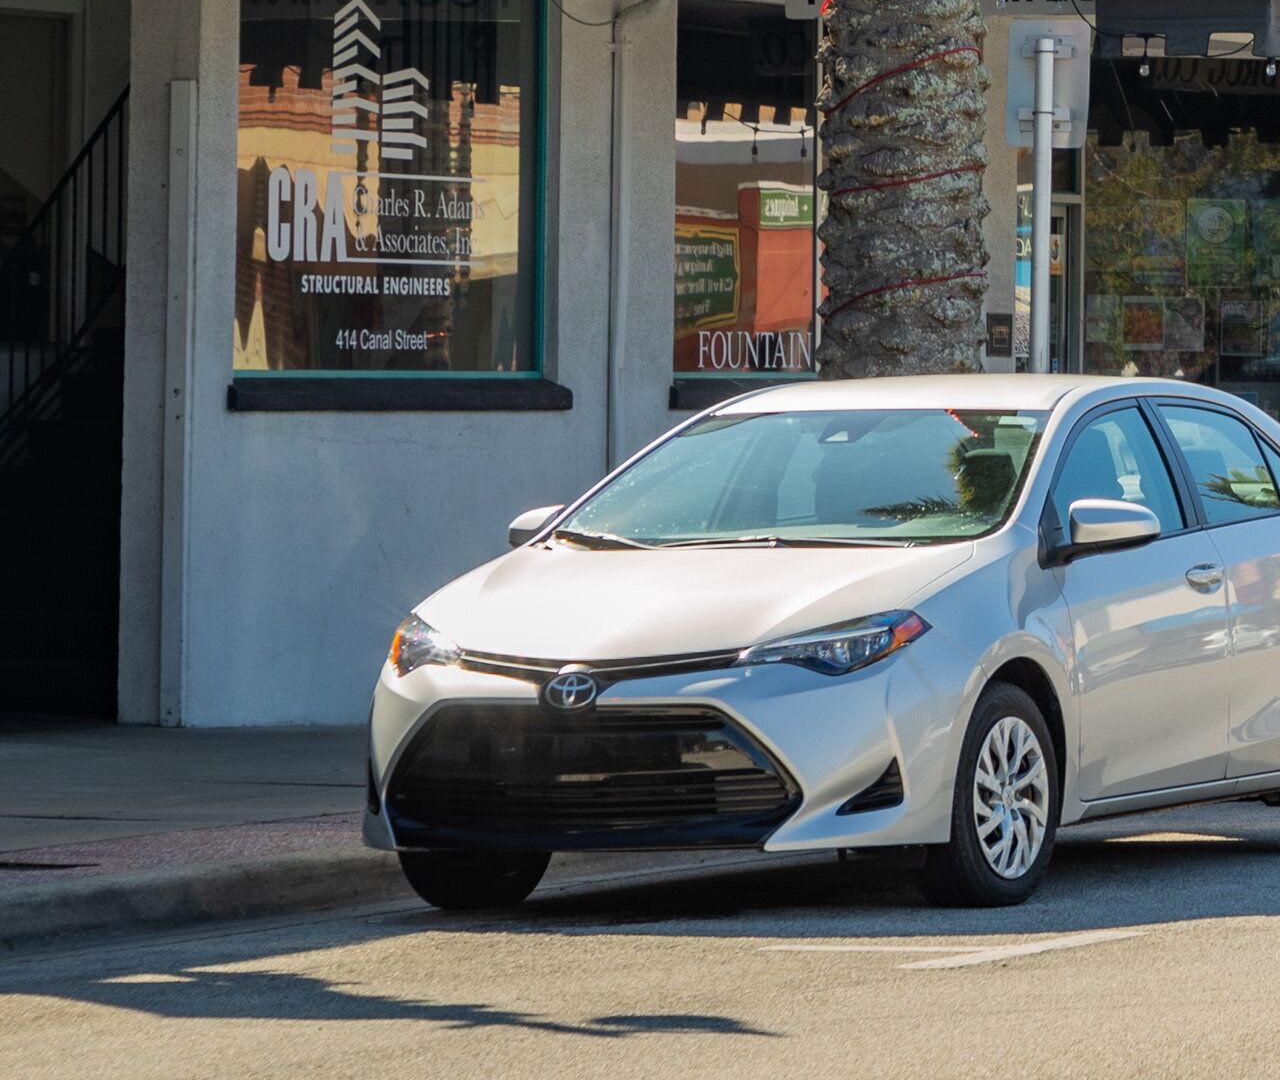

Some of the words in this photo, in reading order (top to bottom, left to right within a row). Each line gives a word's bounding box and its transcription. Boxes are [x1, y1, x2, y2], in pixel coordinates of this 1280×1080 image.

[267, 167, 347, 262] CRA
[353, 185, 410, 218] Charles
[413, 189, 431, 219] R.
[435, 191, 485, 221] Adams
[355, 233, 369, 252] &
[373, 225, 451, 261] Associates,
[301, 274, 379, 294] STRUCTURAL
[383, 277, 451, 296] ENGINEERS
[335, 329, 357, 350] 414
[359, 329, 392, 350] Canal
[395, 329, 428, 350] Street
[698, 331, 813, 370] FOUNTAIN
